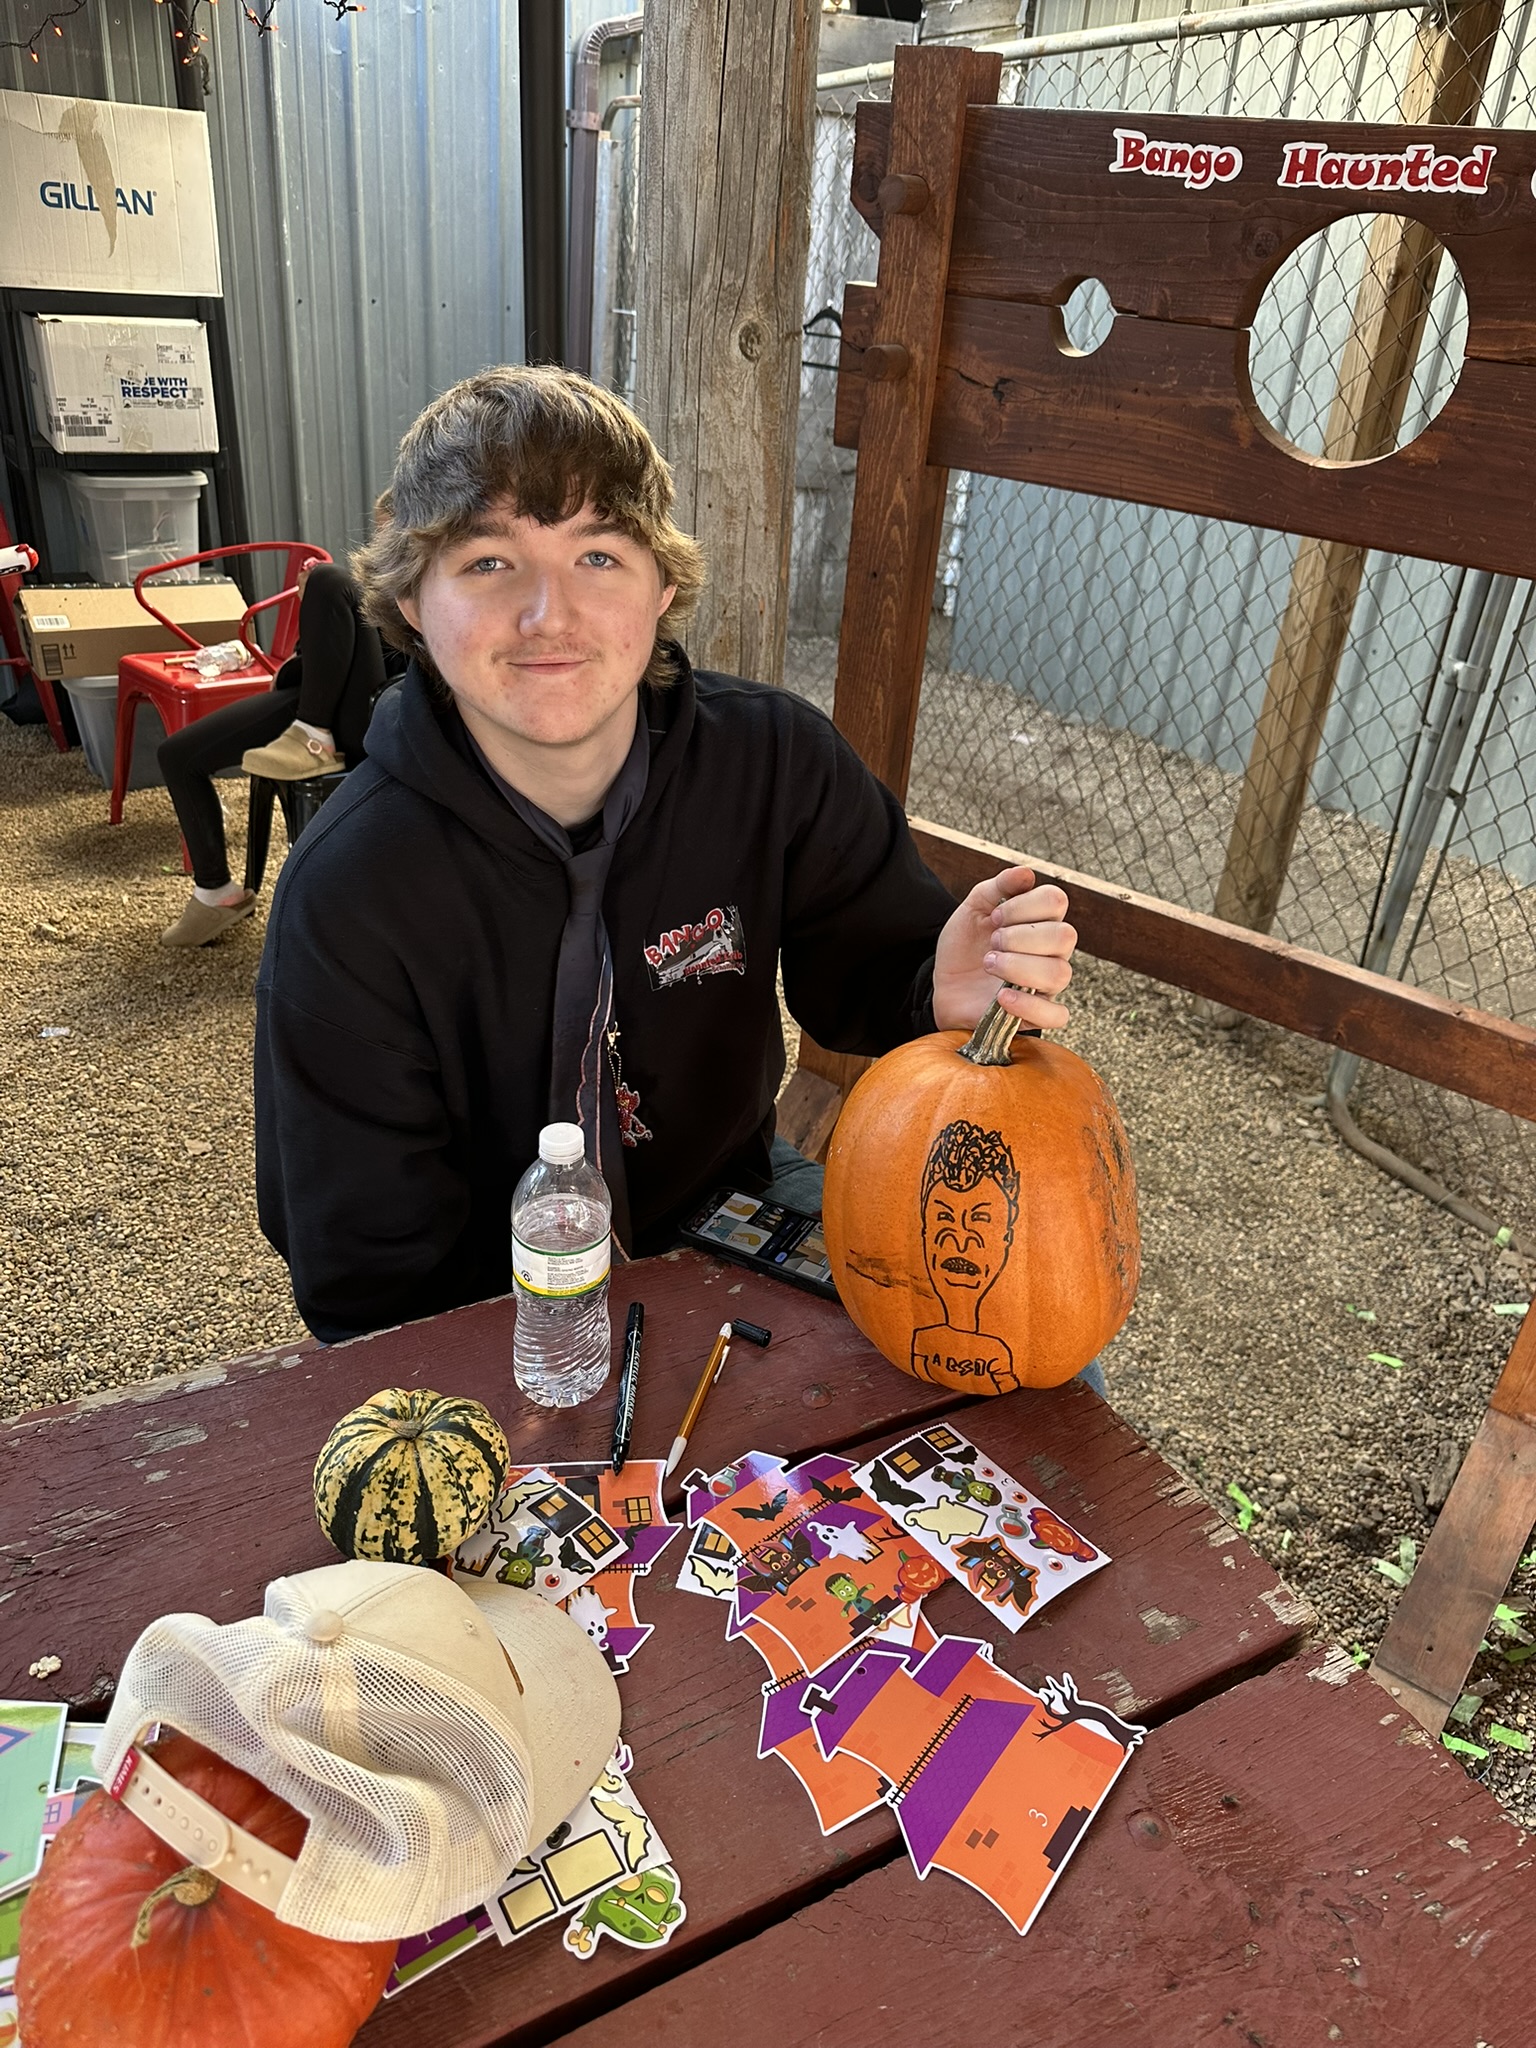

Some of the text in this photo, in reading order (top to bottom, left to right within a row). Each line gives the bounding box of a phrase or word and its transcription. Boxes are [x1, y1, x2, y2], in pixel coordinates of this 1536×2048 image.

[1111, 130, 1242, 189] Bango
[1279, 143, 1496, 194] Haunted
[121, 387, 188, 398] RESPECT
[157, 377, 188, 386] WITH
[644, 908, 725, 968] BANGO
[626, 1350, 640, 1419] ACRYLIC MARKER
[1028, 1808, 1048, 1827] 3
